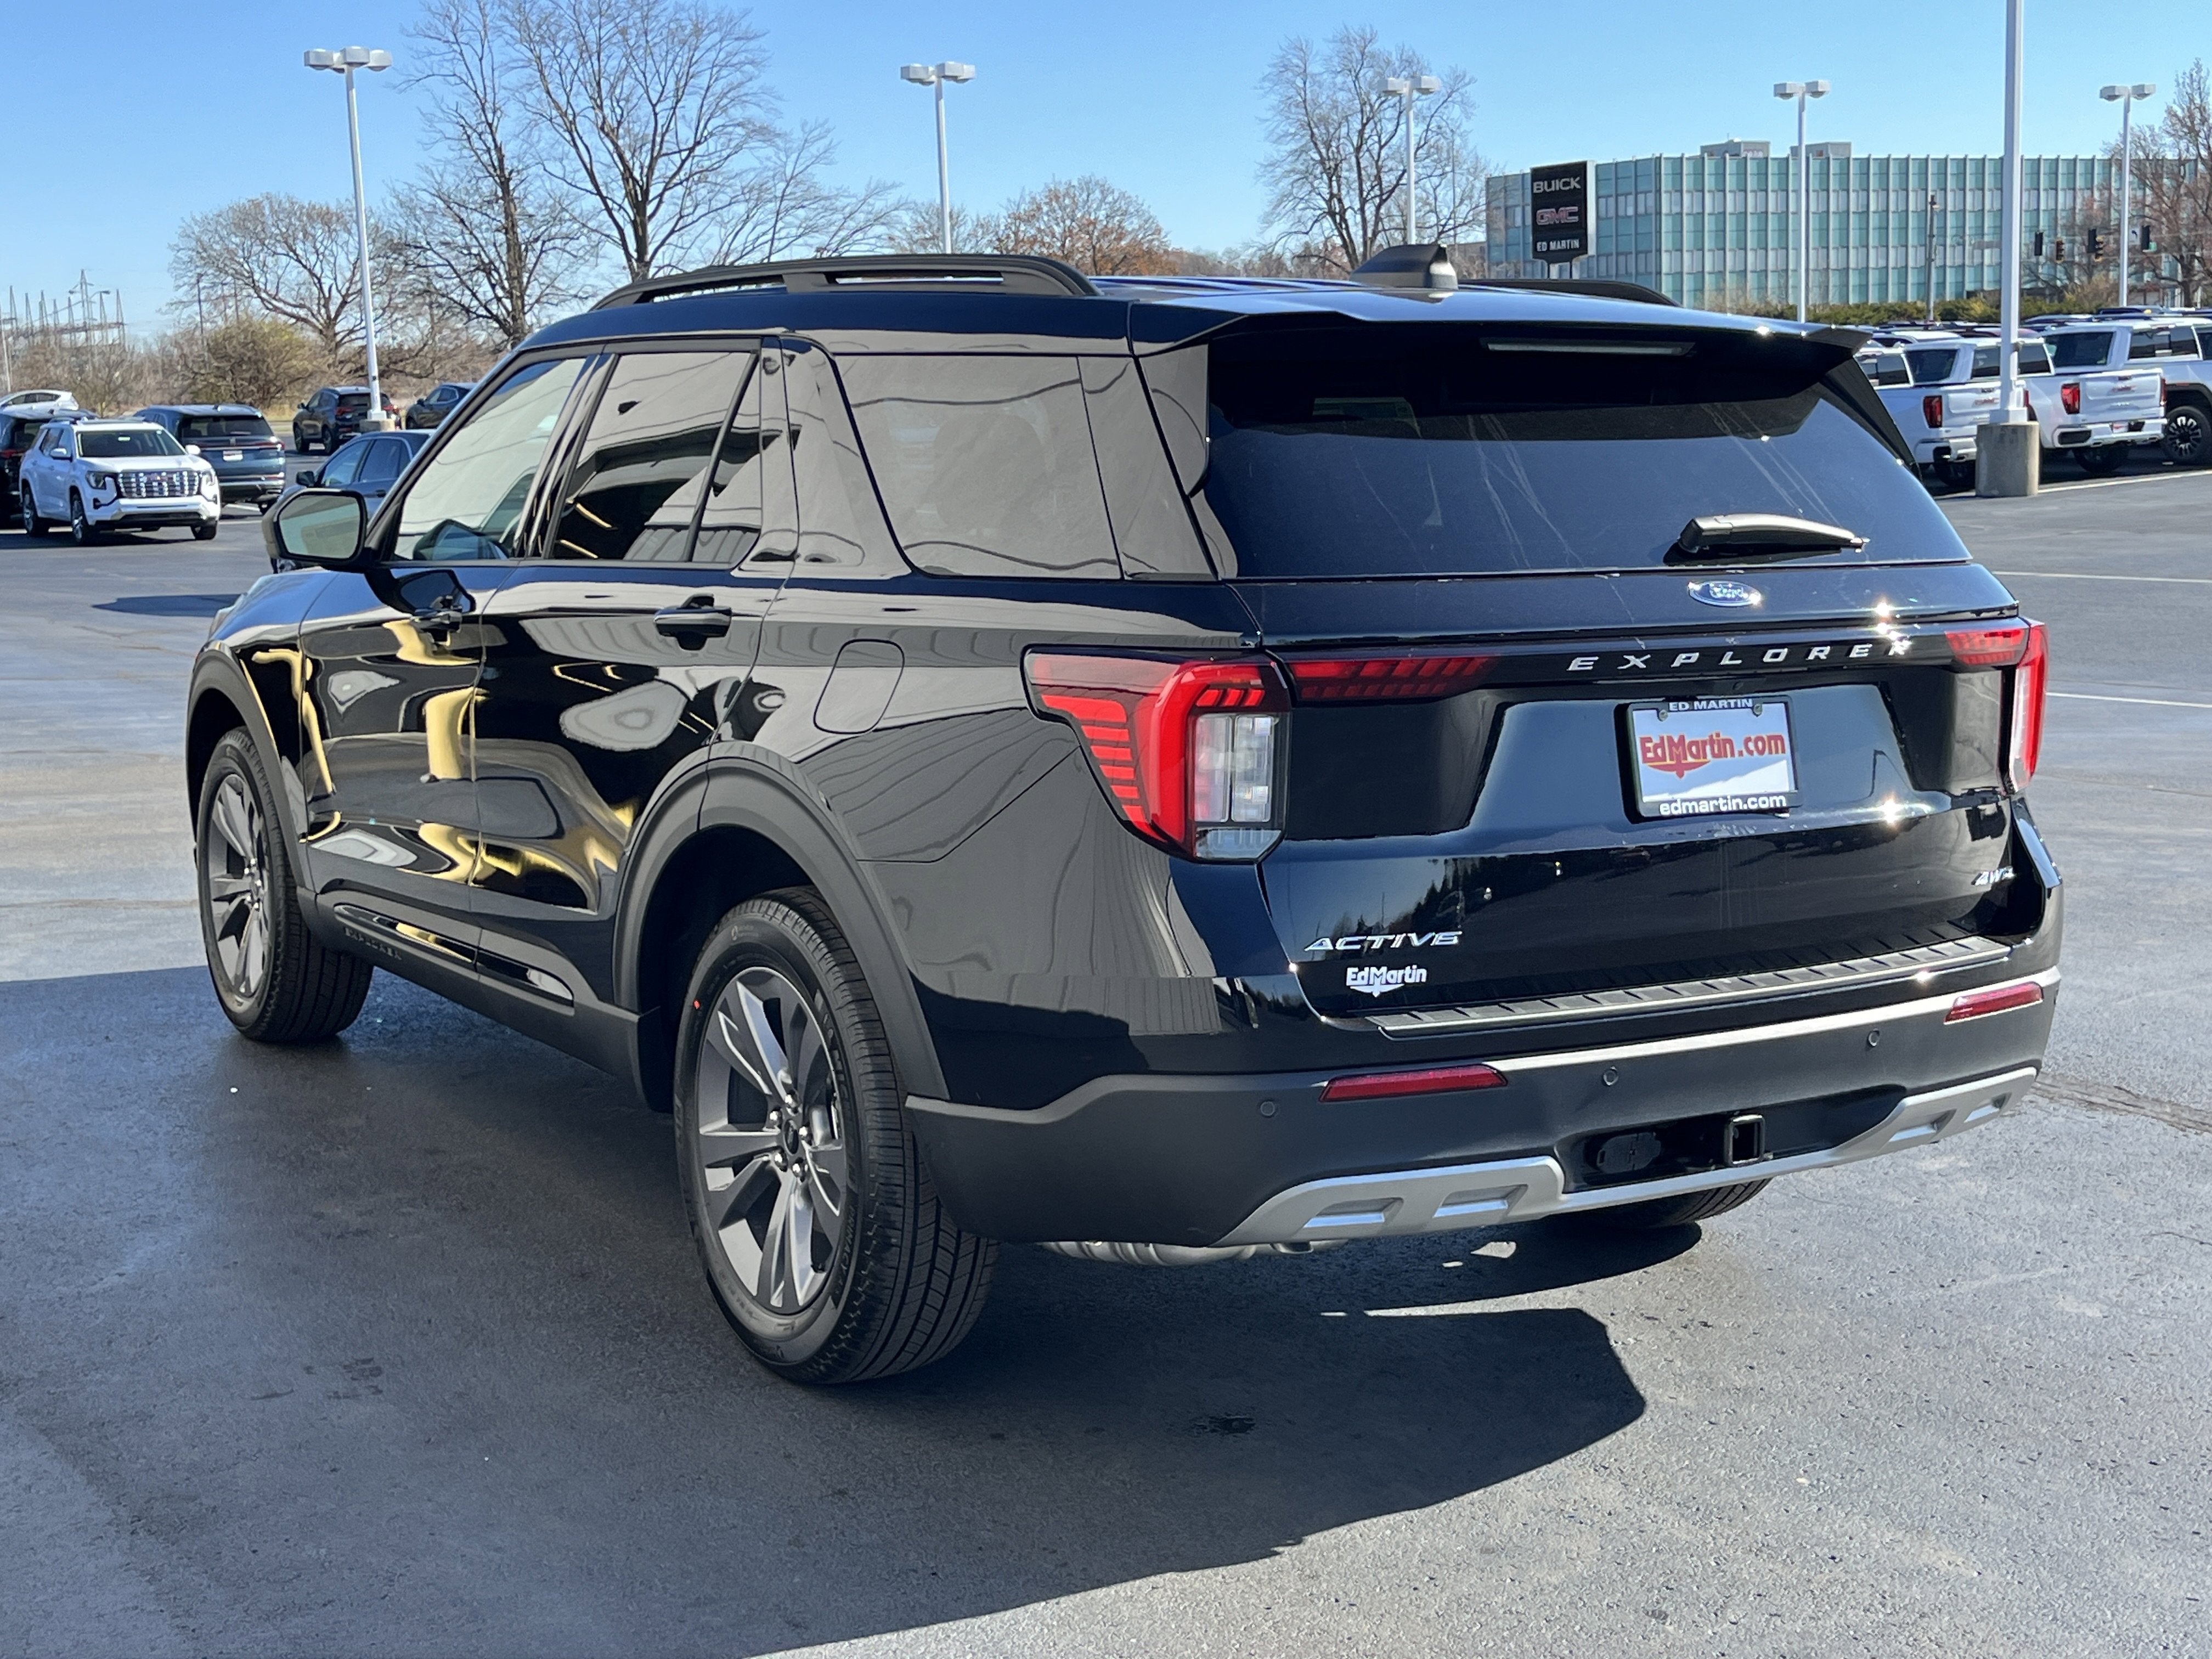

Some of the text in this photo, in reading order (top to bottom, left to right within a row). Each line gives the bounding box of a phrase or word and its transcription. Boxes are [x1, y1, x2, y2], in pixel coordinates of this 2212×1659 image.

[1533, 176, 1581, 193] BUICK
[1537, 206, 1578, 225] GMC
[1537, 239, 1579, 251] ED MARTIN
[1566, 639, 1912, 672] EXPLORER
[1669, 698, 1753, 711] ED MARTIN
[1660, 795, 1786, 815] edmartin.com
[1304, 931, 1463, 952] ACTIVE
